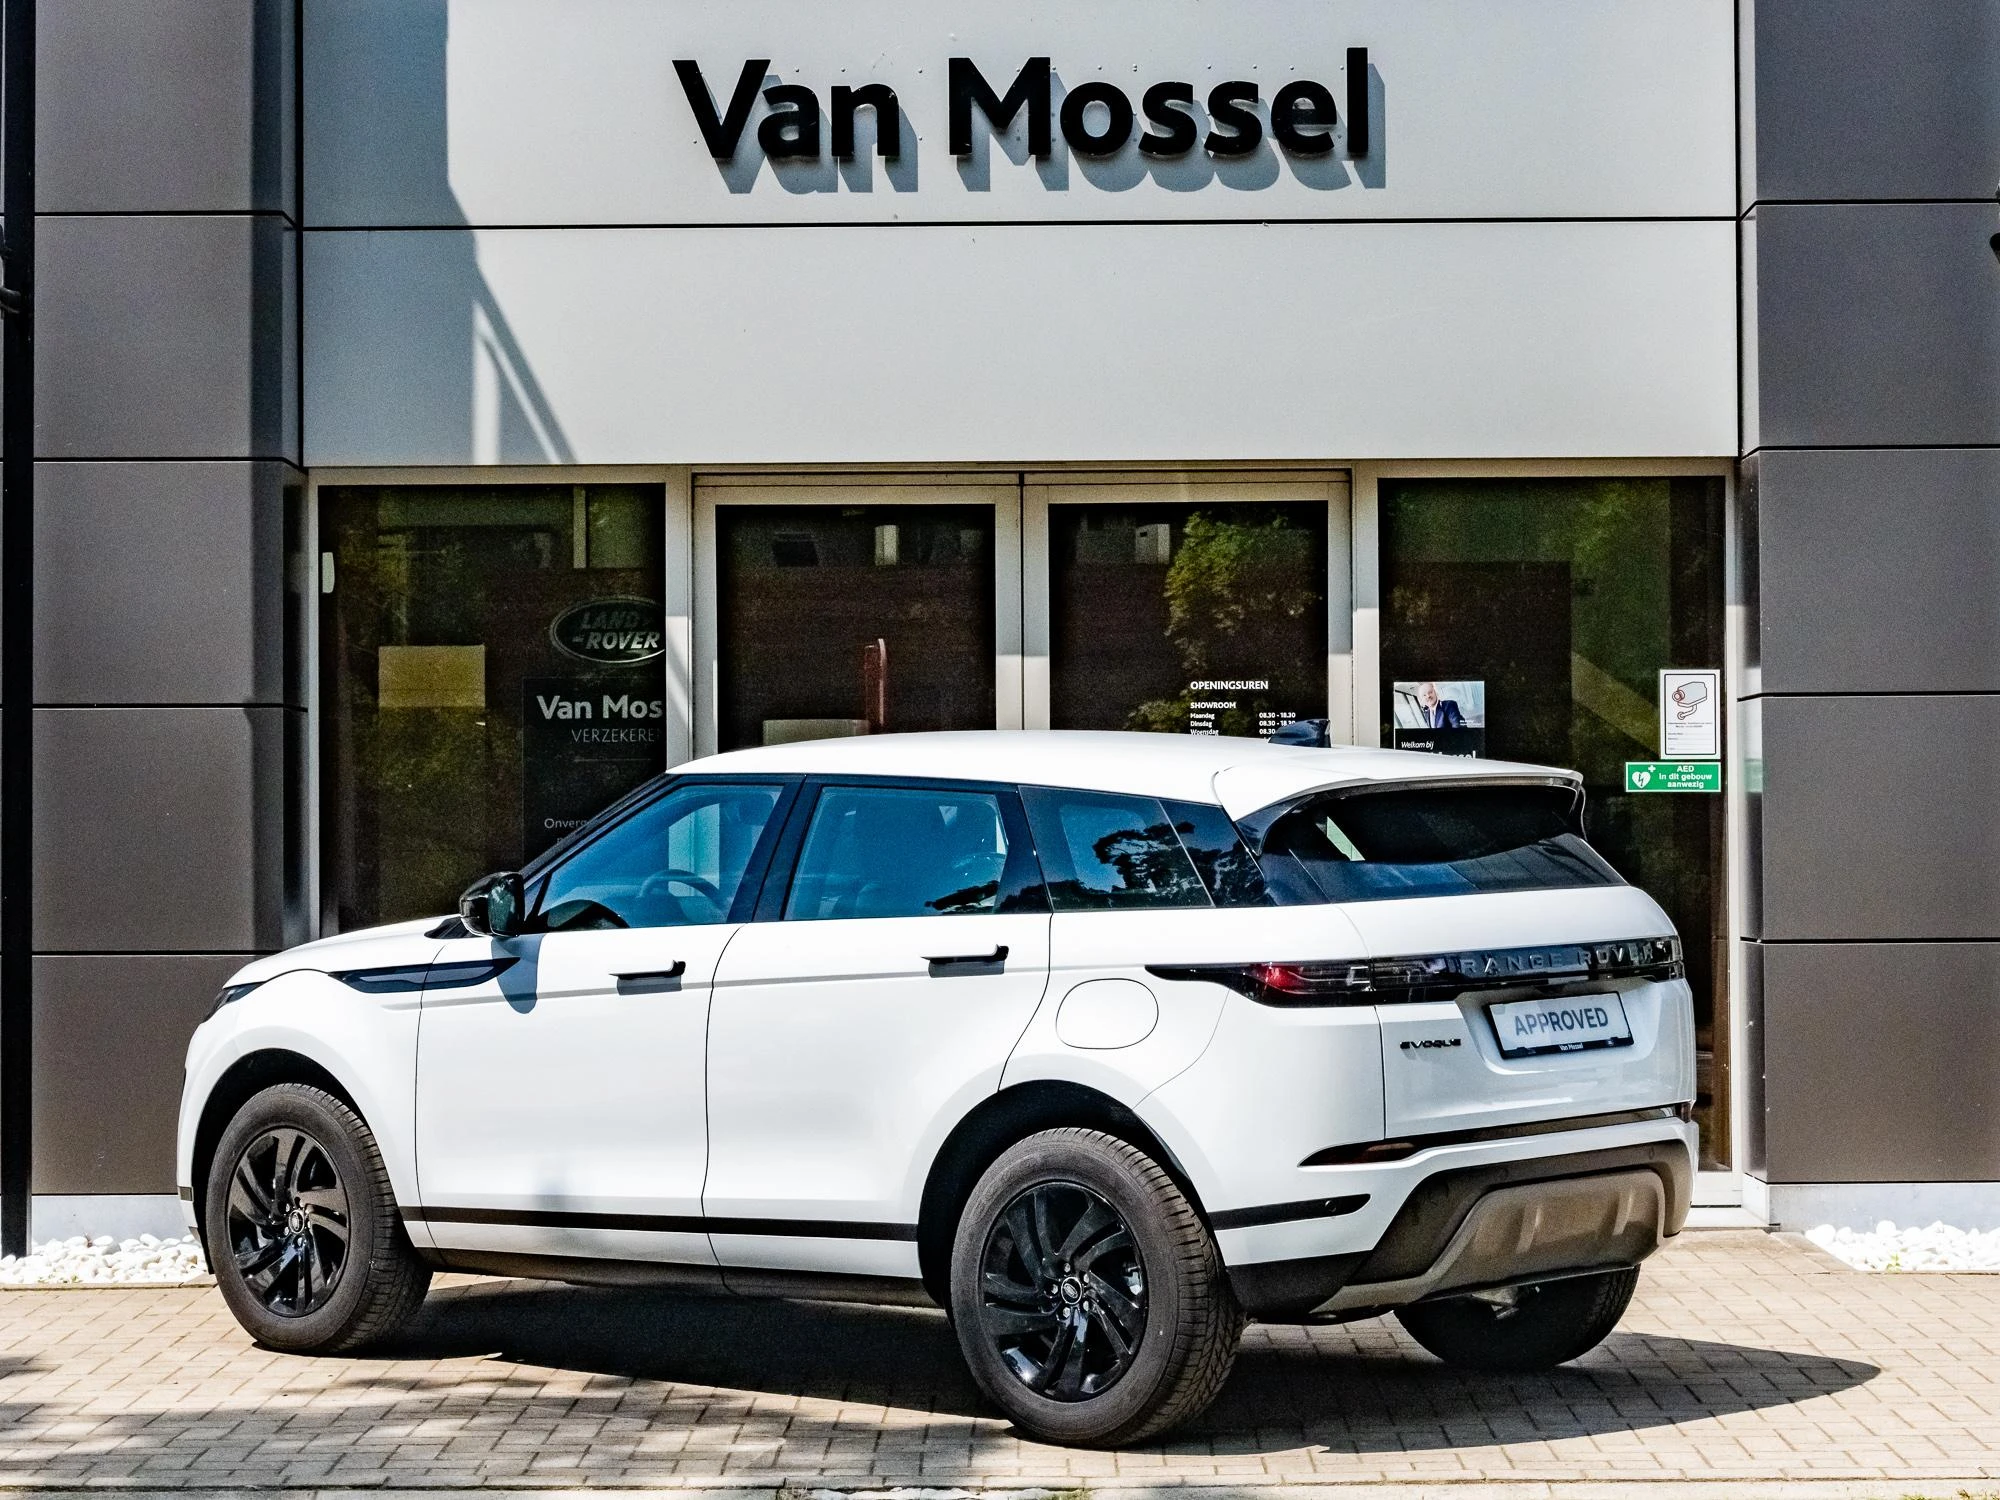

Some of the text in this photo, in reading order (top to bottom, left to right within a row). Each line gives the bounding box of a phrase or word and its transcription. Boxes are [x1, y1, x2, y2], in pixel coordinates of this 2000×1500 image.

[672, 47, 1369, 159] Van Mossel
[581, 611, 640, 630] LAND
[585, 631, 660, 650] ROVER
[1190, 680, 1269, 690] OPENINGSUREN
[536, 695, 593, 720] Van
[1190, 701, 1237, 709] SHOWROOM
[1190, 712, 1215, 720] Maandag
[1258, 711, 1276, 719] 08.30
[1280, 711, 1296, 719] 18.30
[1190, 720, 1213, 728] Dinsdag
[1401, 740, 1434, 750] Welkom bij
[1676, 765, 1695, 773] AED
[1681, 773, 1713, 782] gebouw
[1667, 781, 1705, 789] aanwezig
[1460, 943, 1654, 976] RANGE ROVER
[1514, 1006, 1610, 1036] APPROVED
